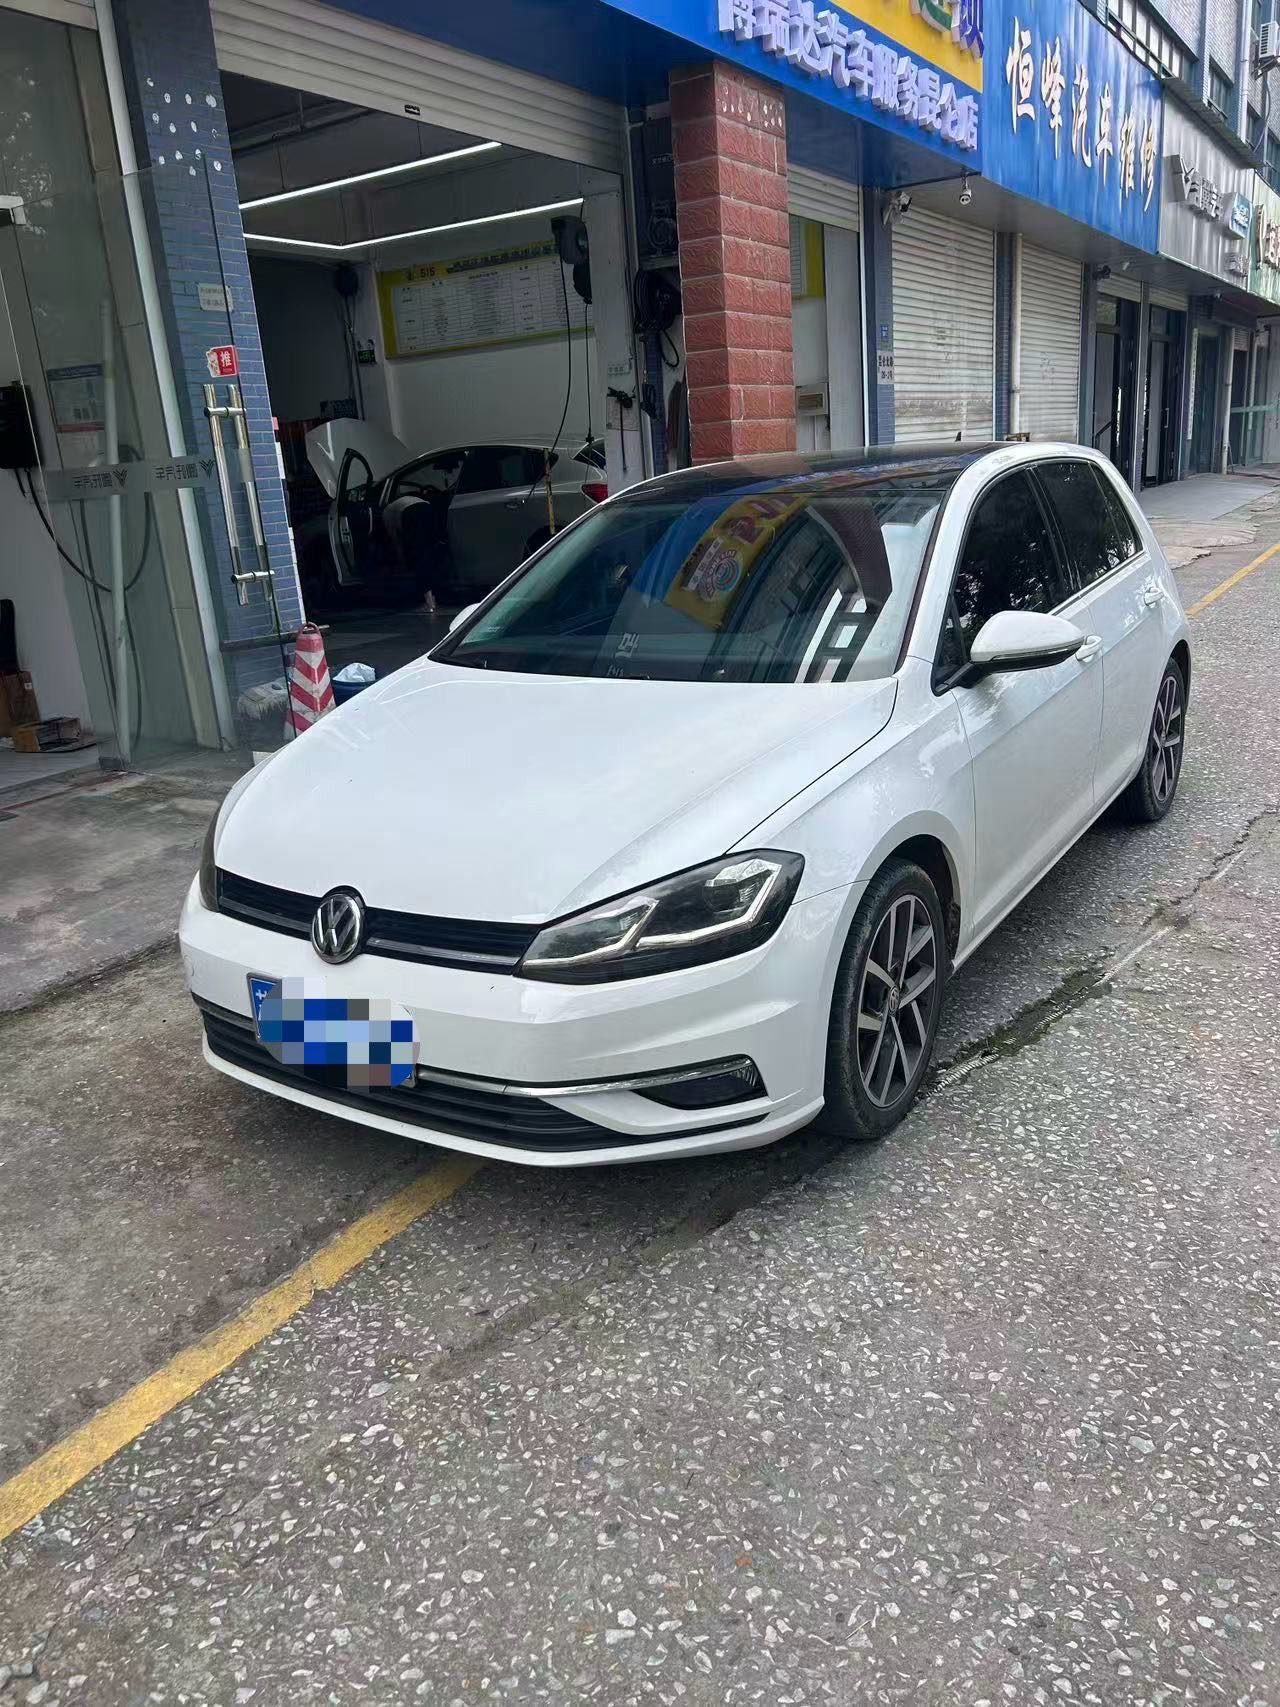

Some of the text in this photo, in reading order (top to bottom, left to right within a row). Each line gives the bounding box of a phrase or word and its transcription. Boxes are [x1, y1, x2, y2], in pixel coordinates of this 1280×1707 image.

[1006, 16, 1156, 212] 恒峰汽车维修
[219, 350, 232, 367] 推
